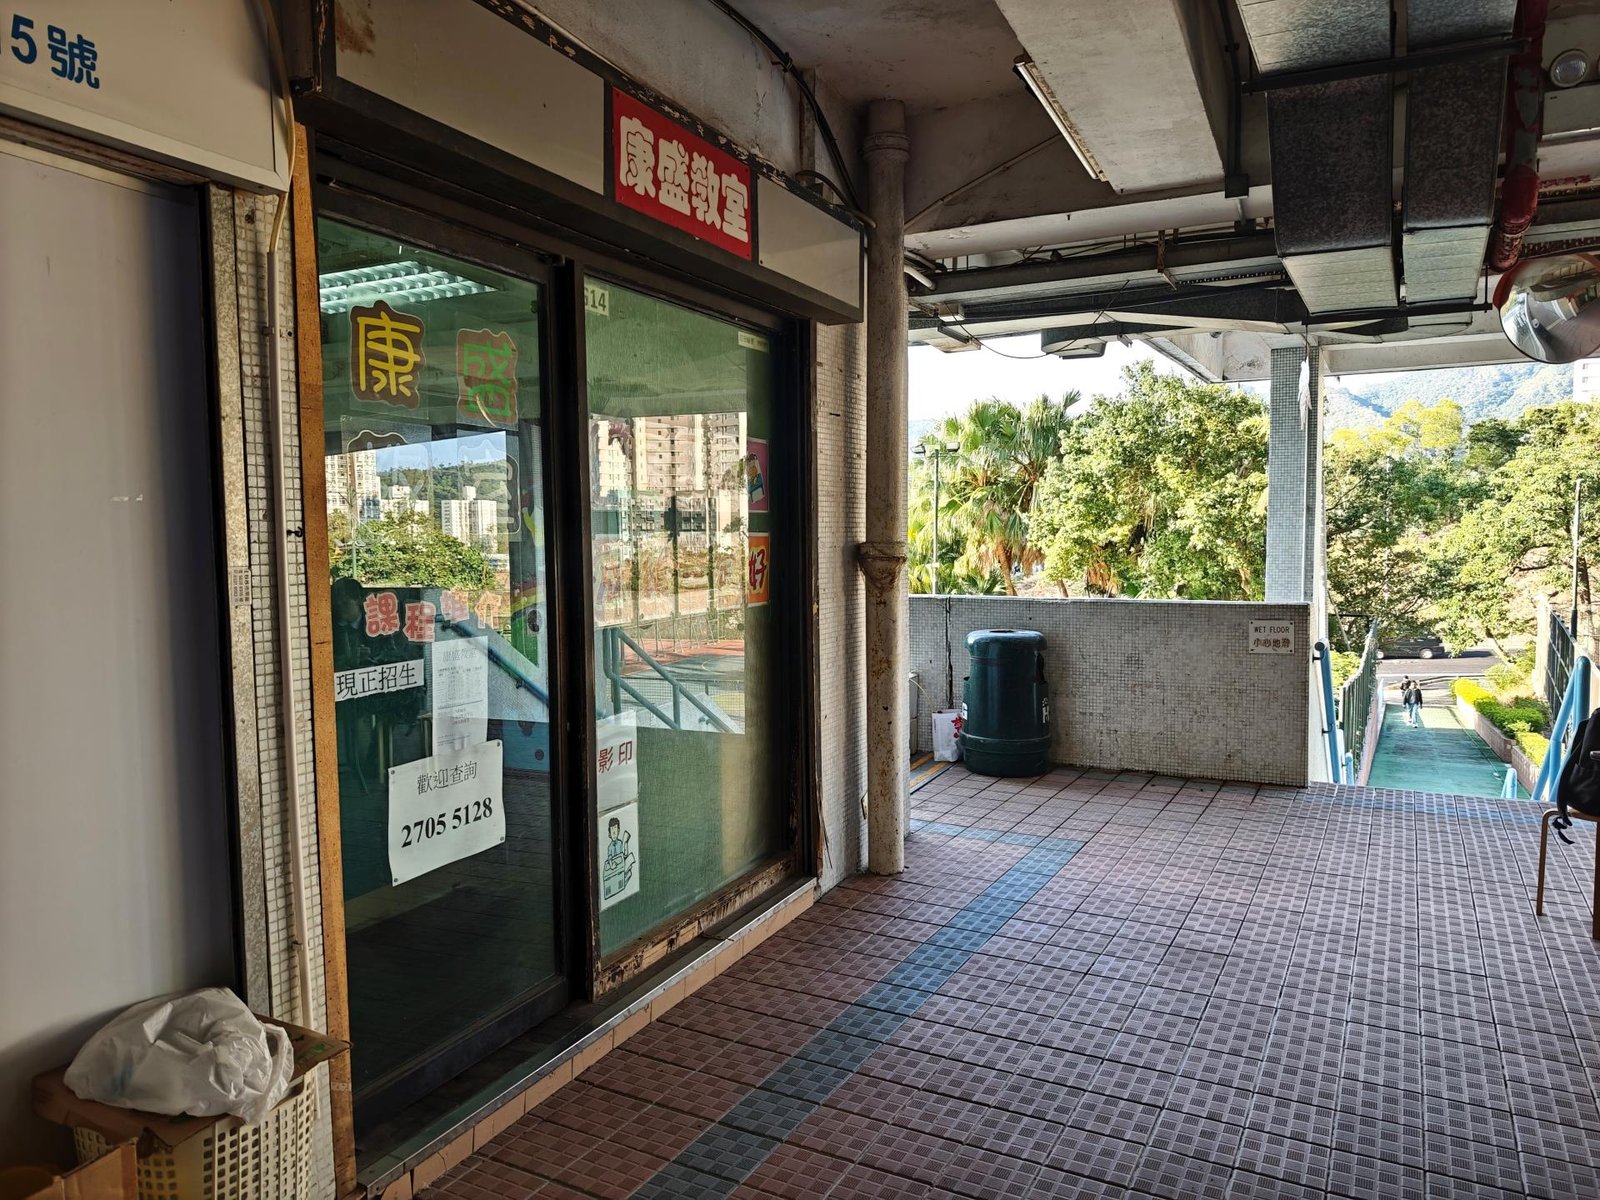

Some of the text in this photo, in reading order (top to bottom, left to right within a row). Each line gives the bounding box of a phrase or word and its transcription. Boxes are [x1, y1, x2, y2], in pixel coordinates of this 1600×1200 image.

[0, 14, 100, 90] 5號
[619, 115, 749, 243] 康盛教室
[1253, 637, 1291, 649] 小心地滑
[1254, 626, 1290, 634] WET FLOOR
[336, 663, 418, 699] 現正招生
[598, 740, 633, 774] 影印
[417, 760, 478, 796] 歡迎查詢
[401, 797, 493, 848] 2705 5128
